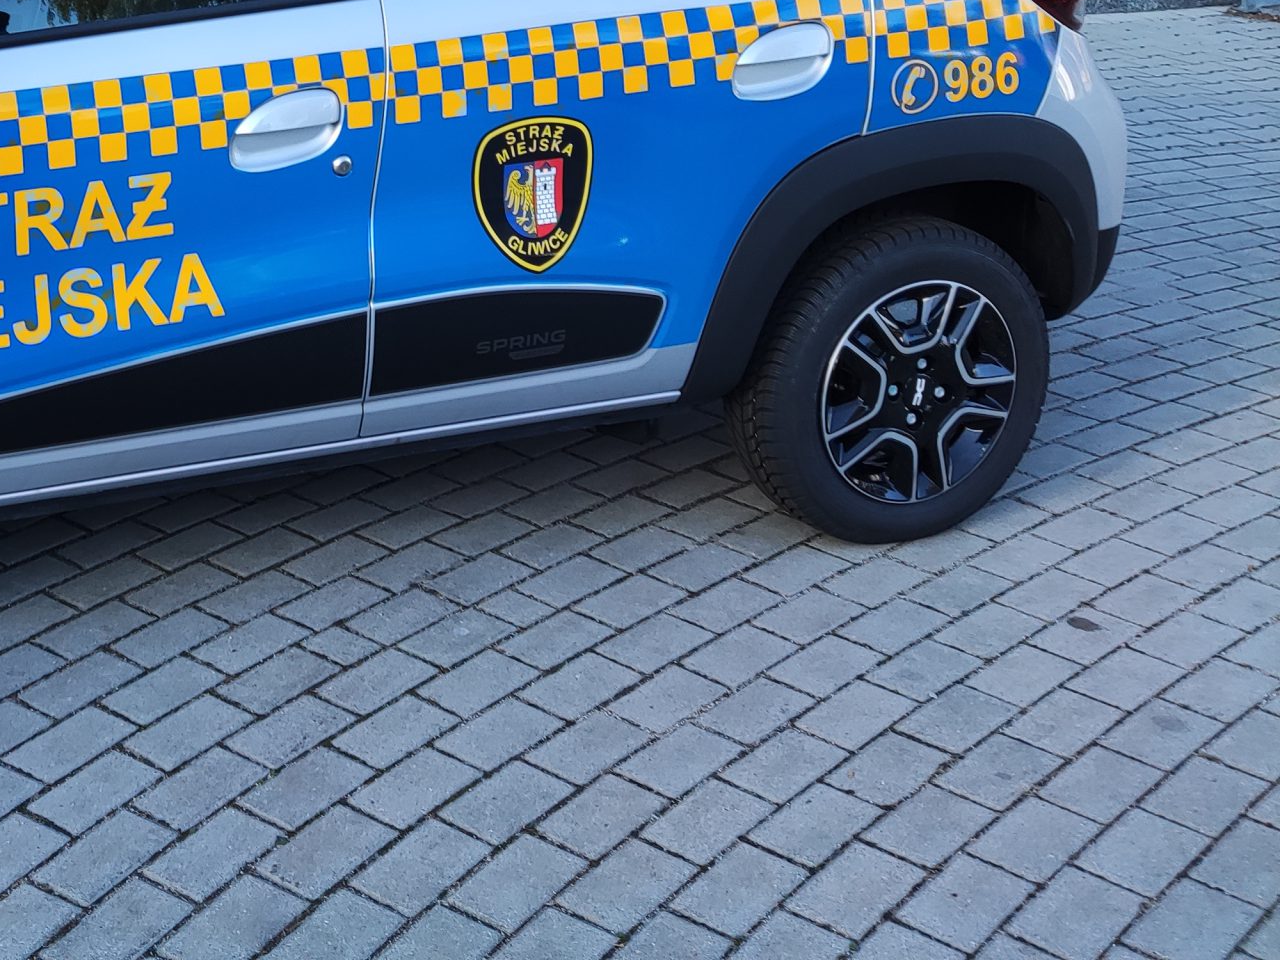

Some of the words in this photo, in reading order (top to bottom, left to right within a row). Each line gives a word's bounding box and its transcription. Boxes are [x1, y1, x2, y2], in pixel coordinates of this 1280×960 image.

[943, 51, 1020, 103] 986
[495, 138, 574, 165] MIEJSKA
[507, 227, 569, 256] GLIWICE
[476, 329, 566, 355] SPRING
